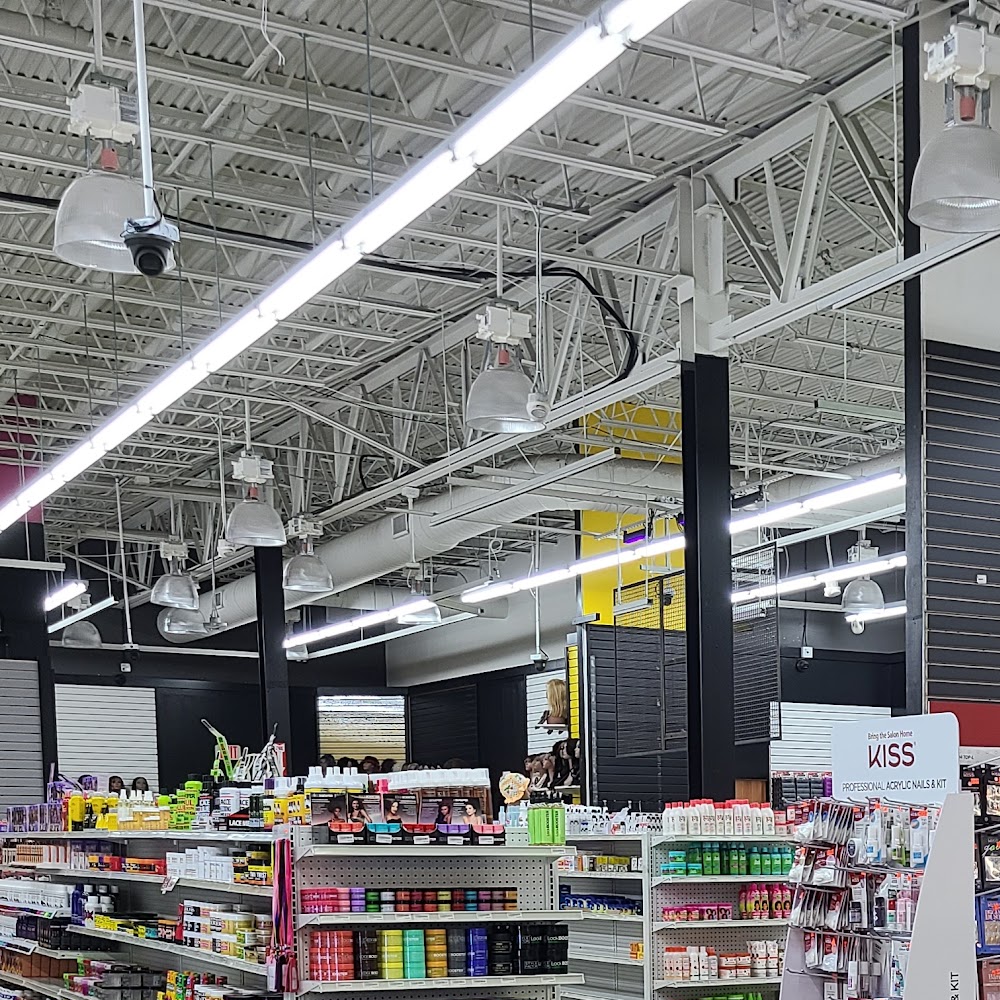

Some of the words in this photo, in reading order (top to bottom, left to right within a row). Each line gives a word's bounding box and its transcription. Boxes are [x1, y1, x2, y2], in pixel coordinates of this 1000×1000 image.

[867, 732, 879, 741] Bring
[887, 731, 899, 739] Salon
[900, 730, 913, 738] Home
[868, 742, 915, 768] KISS
[842, 782, 885, 792] PROFESSIONAL
[886, 780, 911, 791] ACRYLIC
[912, 779, 929, 789] NAILS
[930, 779, 936, 788] &
[936, 779, 947, 788] KIT
[950, 971, 959, 991] KIT
